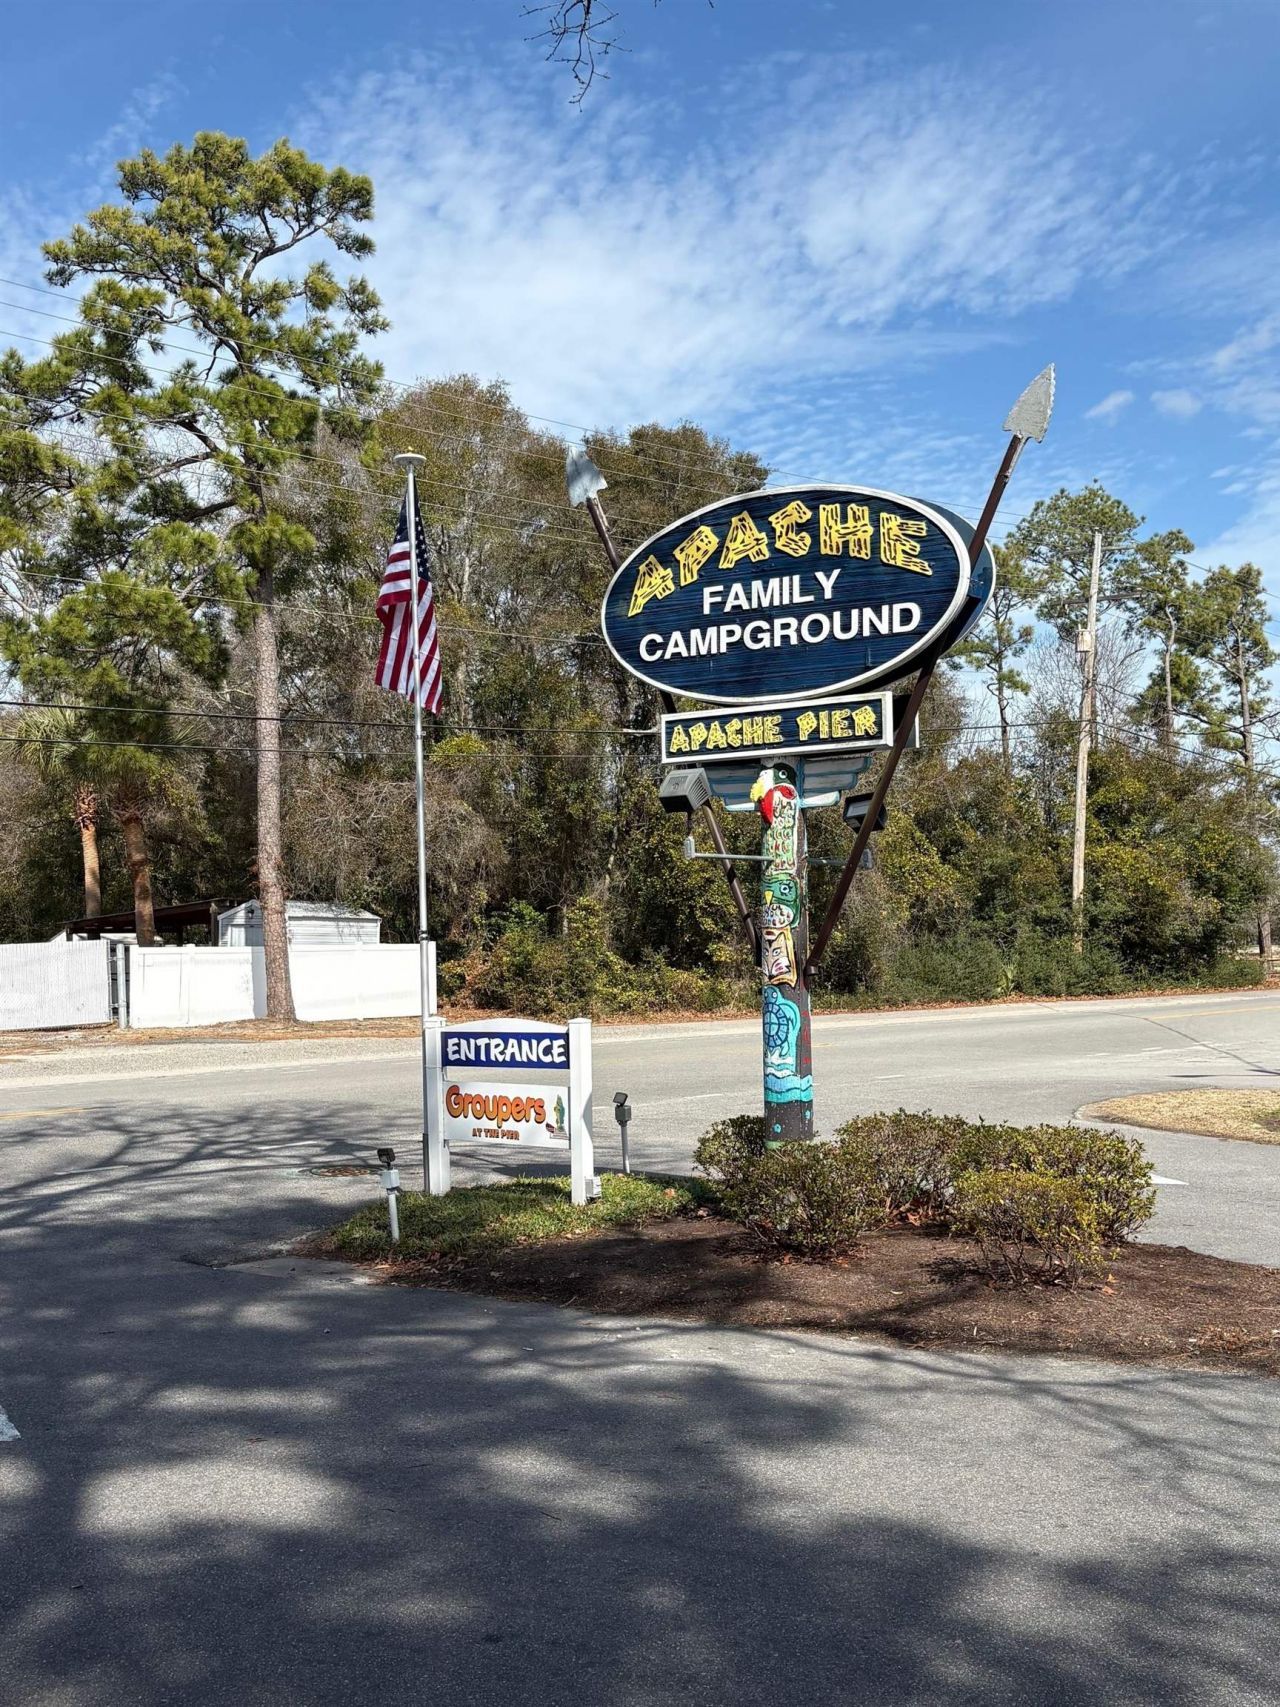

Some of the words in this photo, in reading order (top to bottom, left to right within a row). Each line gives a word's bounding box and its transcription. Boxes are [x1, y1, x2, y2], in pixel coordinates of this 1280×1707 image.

[627, 500, 933, 618] APACHE
[702, 568, 842, 616] FAMILY
[638, 601, 922, 663] CAMPGROUND
[669, 715, 784, 753] APACHE
[796, 705, 879, 741] PIER
[446, 1037, 567, 1064] ENTRANCE
[445, 1084, 546, 1129] Groupers
[472, 1128, 482, 1138] AT
[484, 1128, 499, 1139] THE
[500, 1129, 520, 1141] PIER
